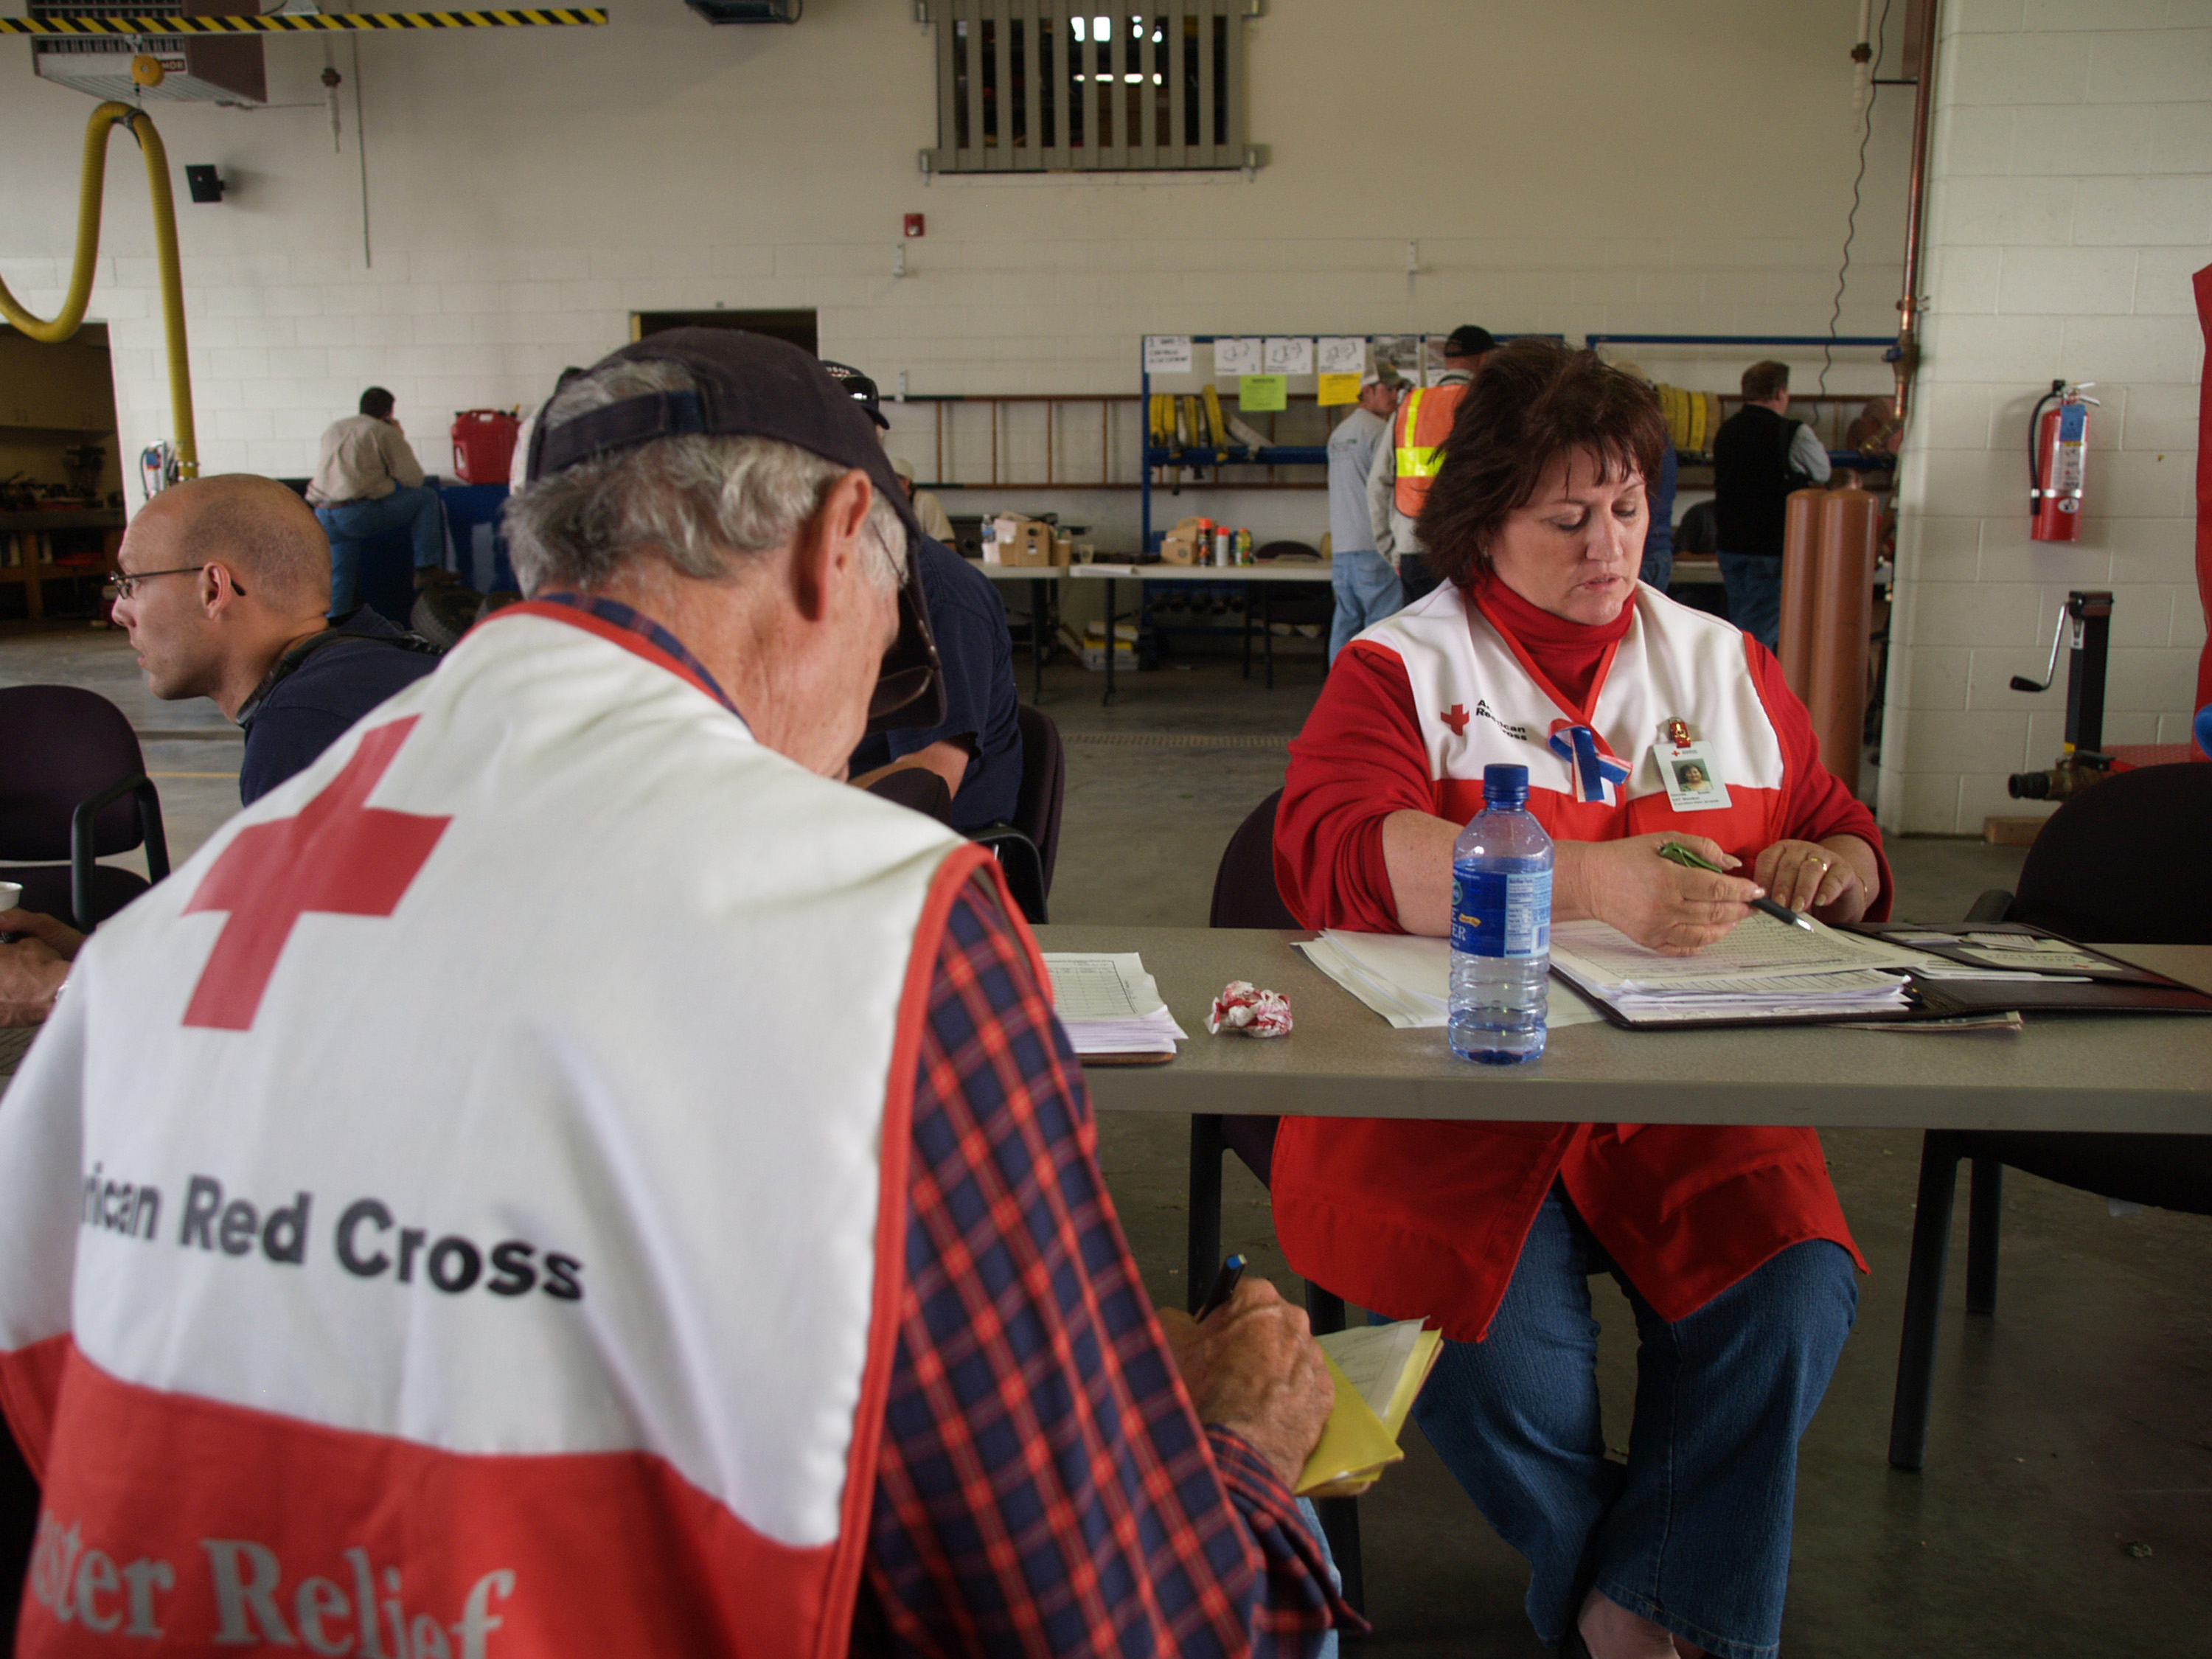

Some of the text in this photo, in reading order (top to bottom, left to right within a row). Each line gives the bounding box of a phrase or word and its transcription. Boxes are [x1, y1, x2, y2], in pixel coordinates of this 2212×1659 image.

[181, 1174, 313, 1266] Red
[335, 1197, 582, 1301] Cross
[199, 1537, 516, 1659] Relief
